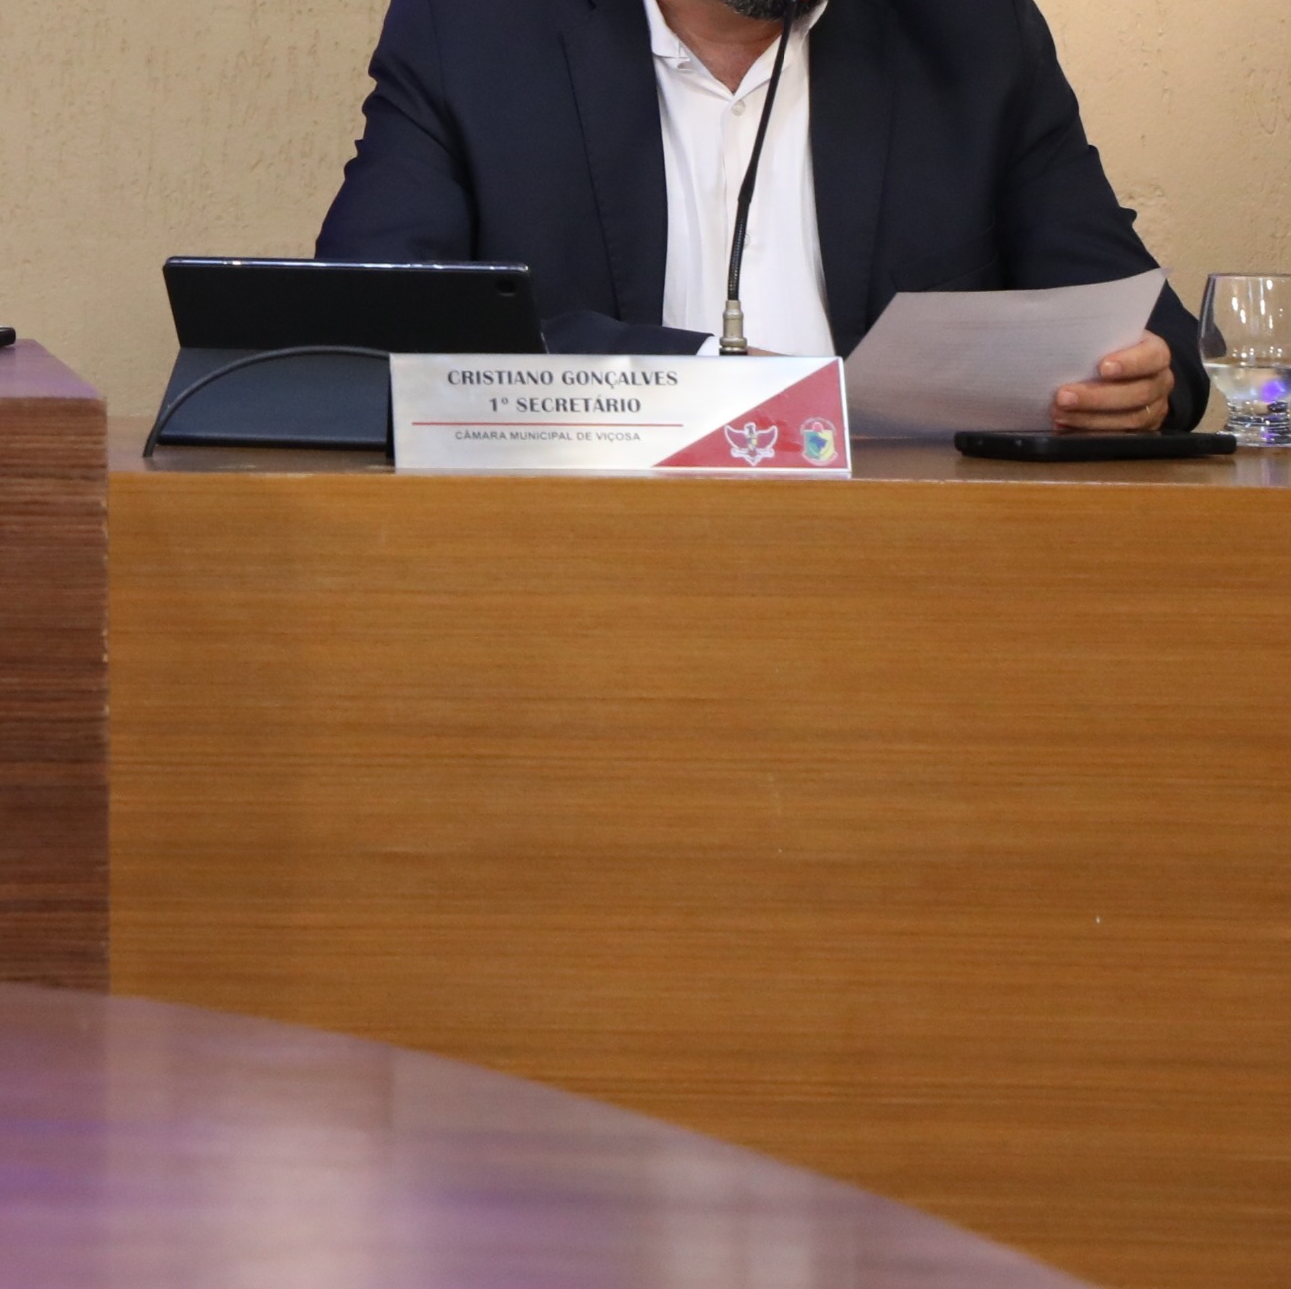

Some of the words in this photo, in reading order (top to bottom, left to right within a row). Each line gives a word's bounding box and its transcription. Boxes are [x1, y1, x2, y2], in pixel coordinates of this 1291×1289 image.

[448, 370, 553, 386] CRISTIANO
[562, 370, 678, 389] GONÇALVES
[489, 398, 509, 412] 1º
[516, 395, 641, 412] SECRETÁRIO
[455, 430, 507, 440] CÂMARA
[510, 431, 572, 441] MUNICIPAL
[577, 432, 592, 441] DE
[596, 432, 640, 442] VIÇOSA
